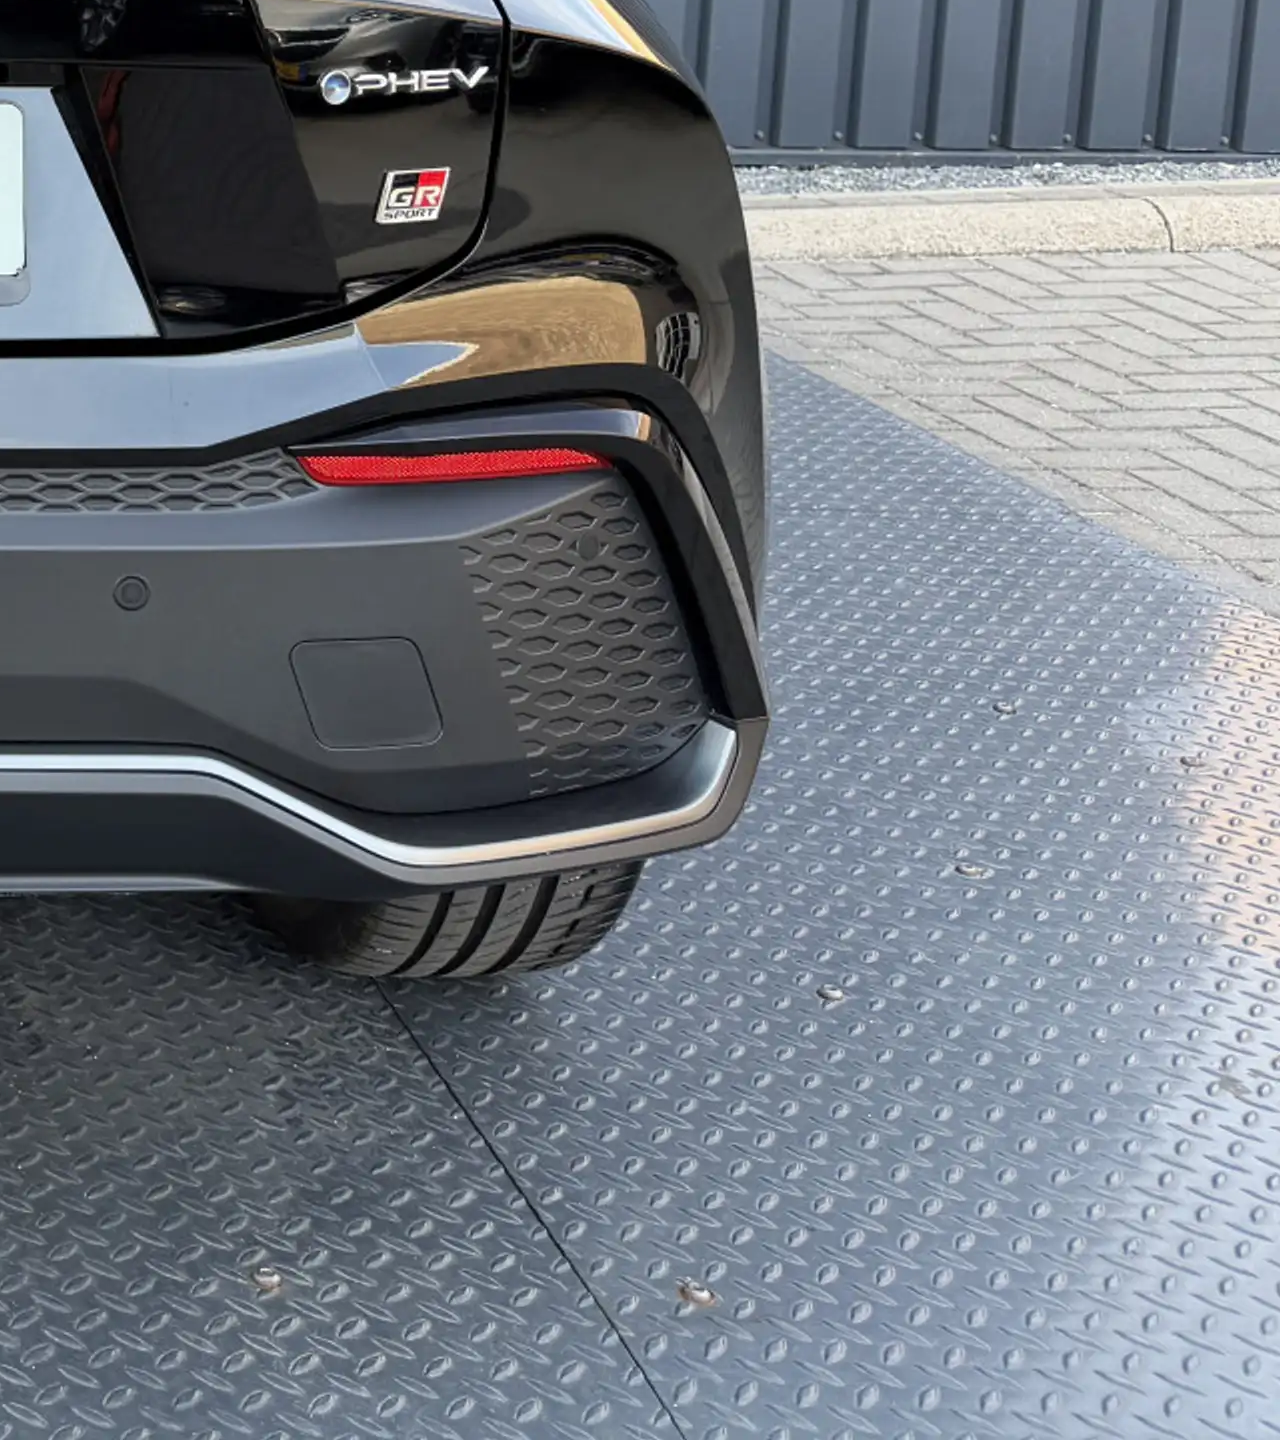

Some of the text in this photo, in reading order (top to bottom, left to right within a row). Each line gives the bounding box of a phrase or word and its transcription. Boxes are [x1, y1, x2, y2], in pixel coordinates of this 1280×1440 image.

[353, 66, 489, 95] PHEV
[388, 186, 441, 208] GR
[384, 208, 437, 220] SPORT
